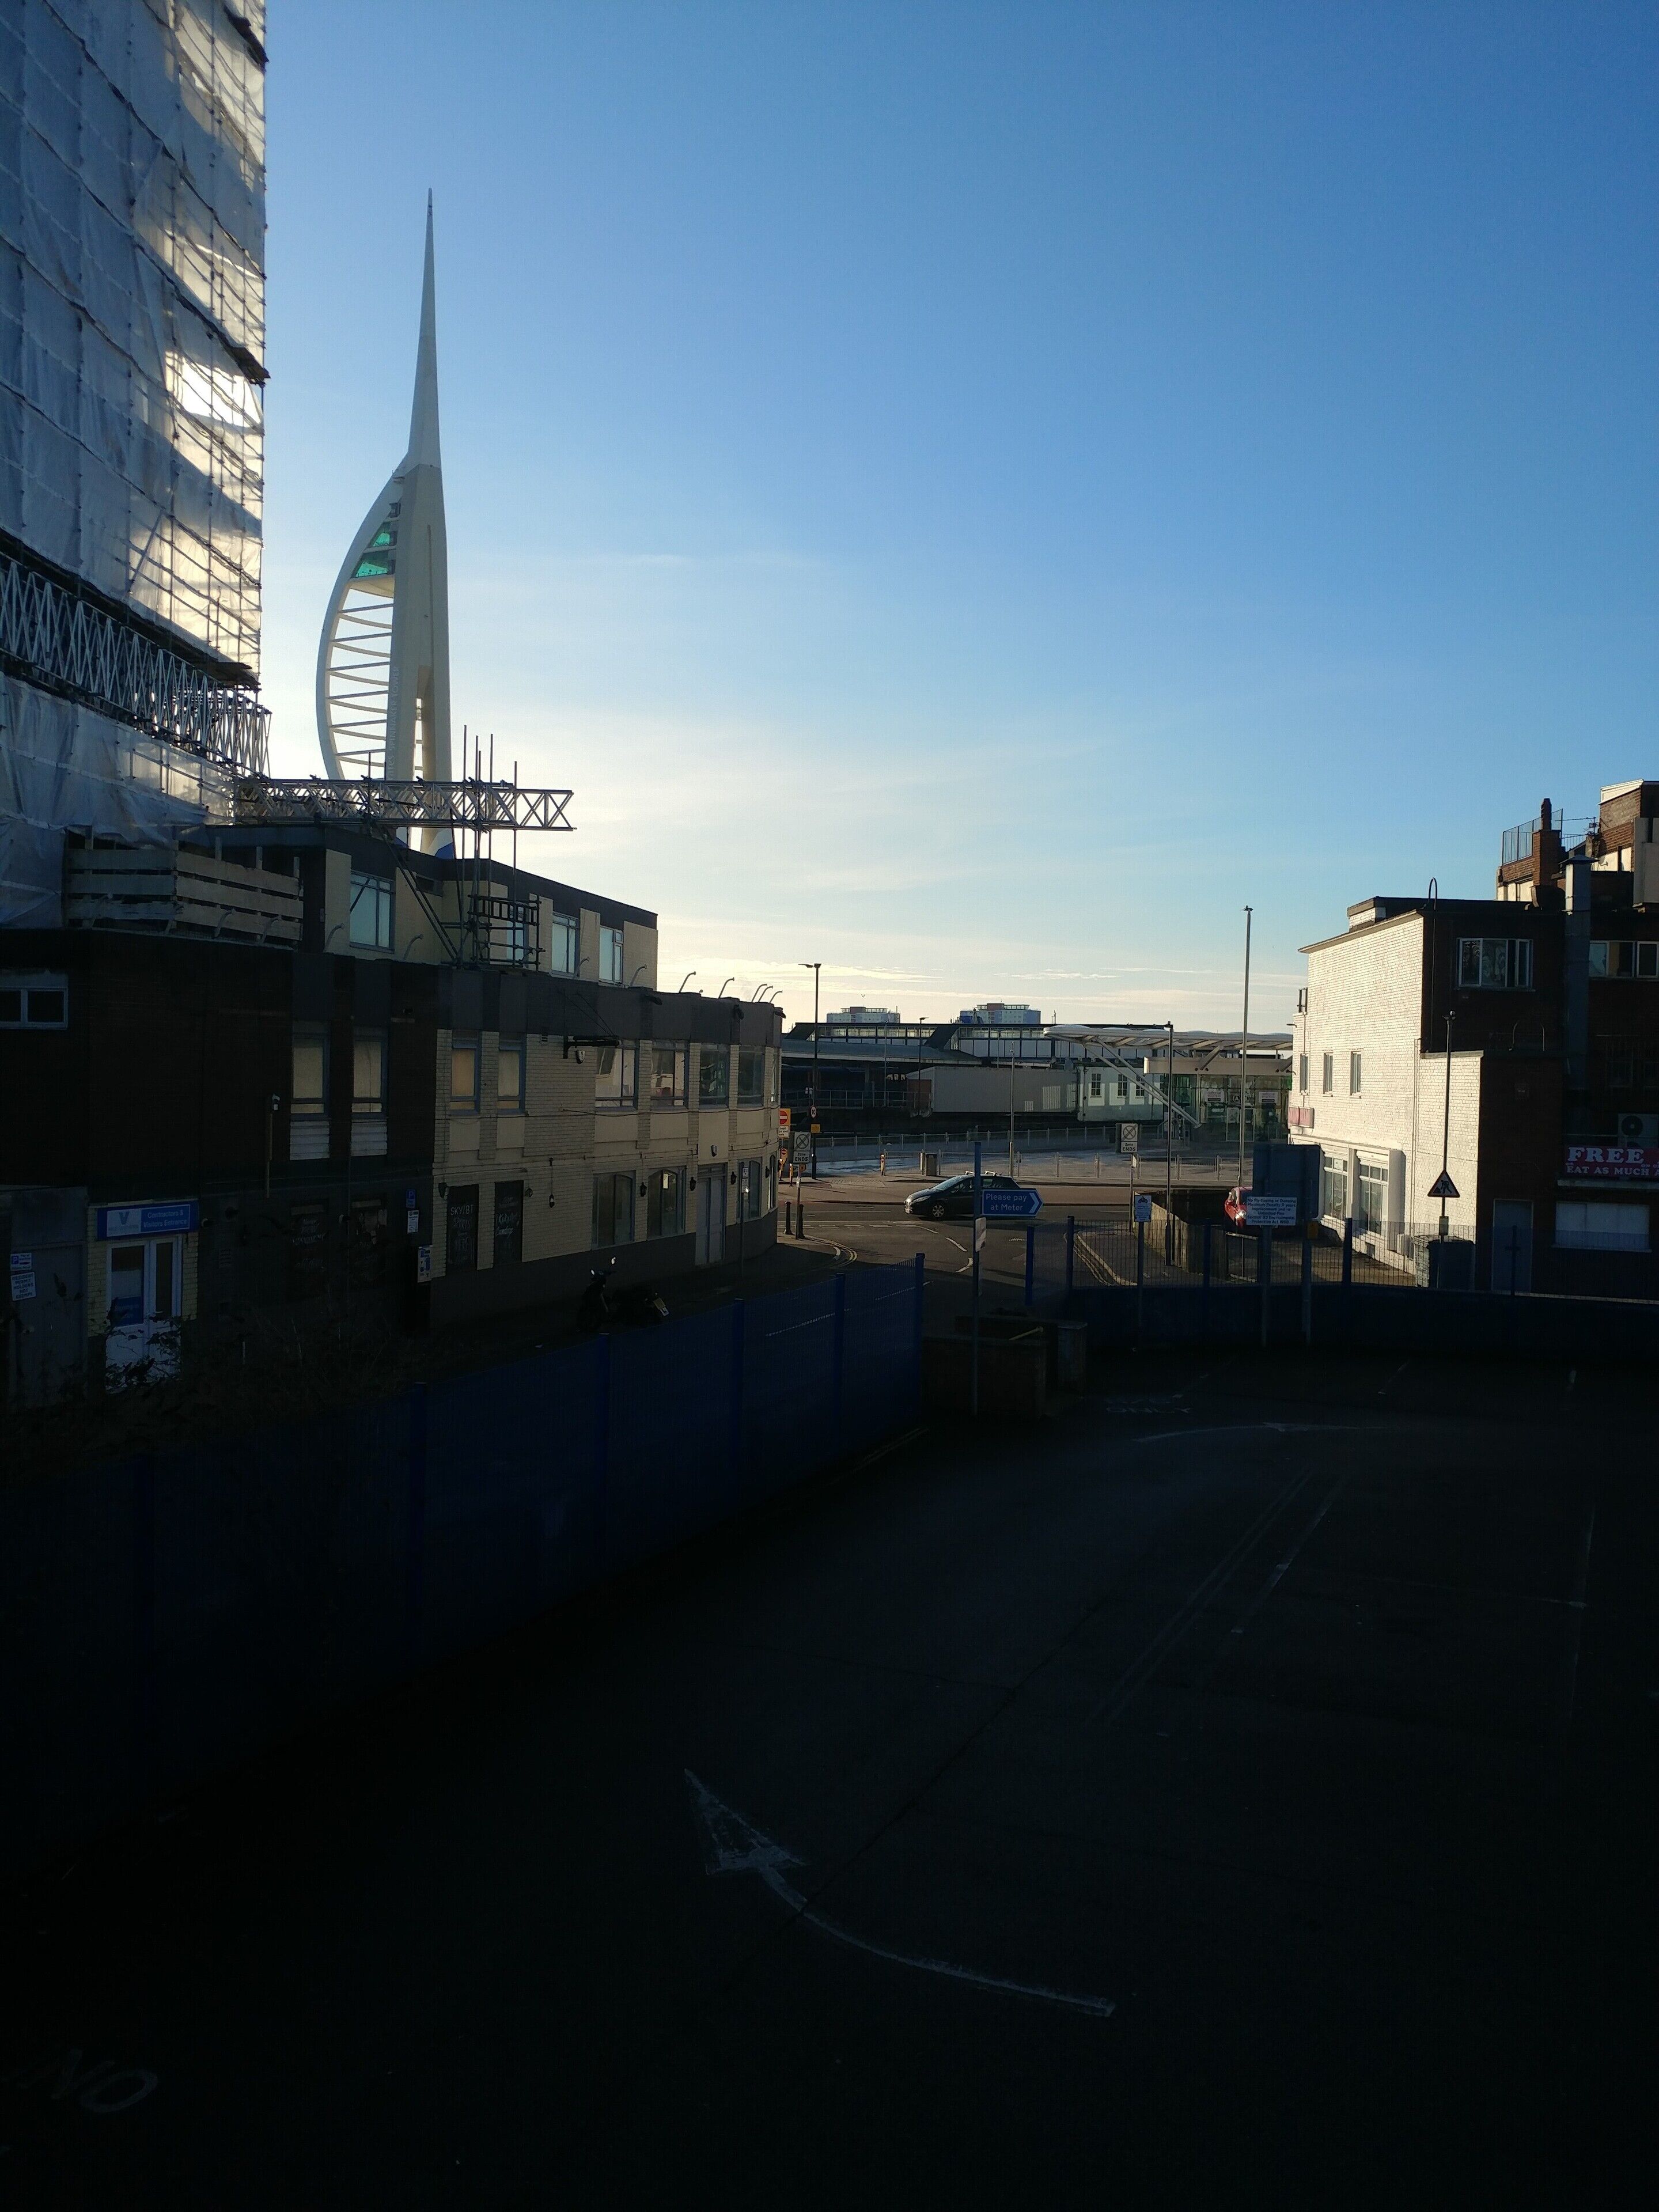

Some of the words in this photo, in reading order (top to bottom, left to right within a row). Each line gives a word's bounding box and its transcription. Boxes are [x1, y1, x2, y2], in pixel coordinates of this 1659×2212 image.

[389, 700, 397, 751] SPINNAKER
[1567, 1147, 1645, 1164] FREE
[1567, 1165, 1589, 1174] EAT
[1594, 1166, 1609, 1175] AS
[1614, 1167, 1650, 1176] MUCH
[147, 1211, 179, 1219] Contractors
[450, 1205, 474, 1215] SKY/BT
[143, 1219, 164, 1228] Visitors
[164, 1218, 188, 1226] Entrance
